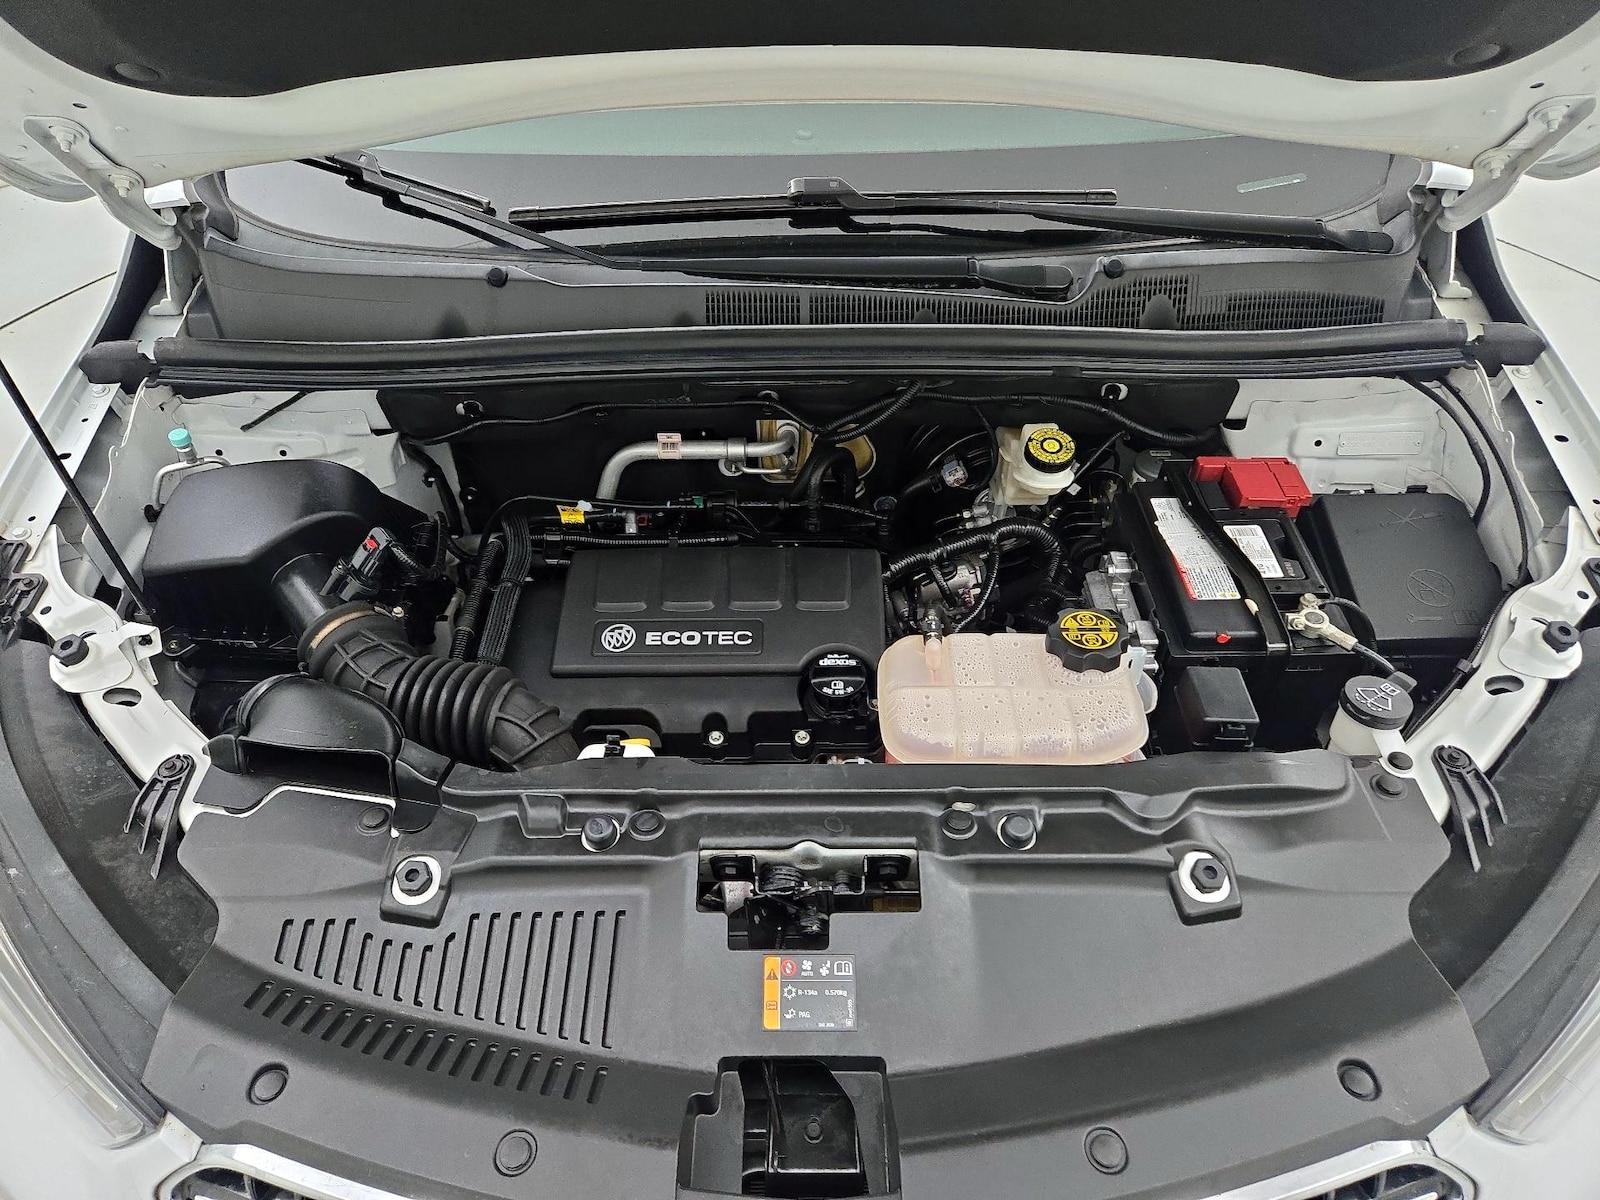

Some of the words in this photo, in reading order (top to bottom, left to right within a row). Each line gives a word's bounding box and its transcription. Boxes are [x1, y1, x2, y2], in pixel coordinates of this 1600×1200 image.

[645, 630, 753, 646] ECOTEC
[818, 658, 857, 666] dexos
[824, 989, 848, 997] 0.570kg
